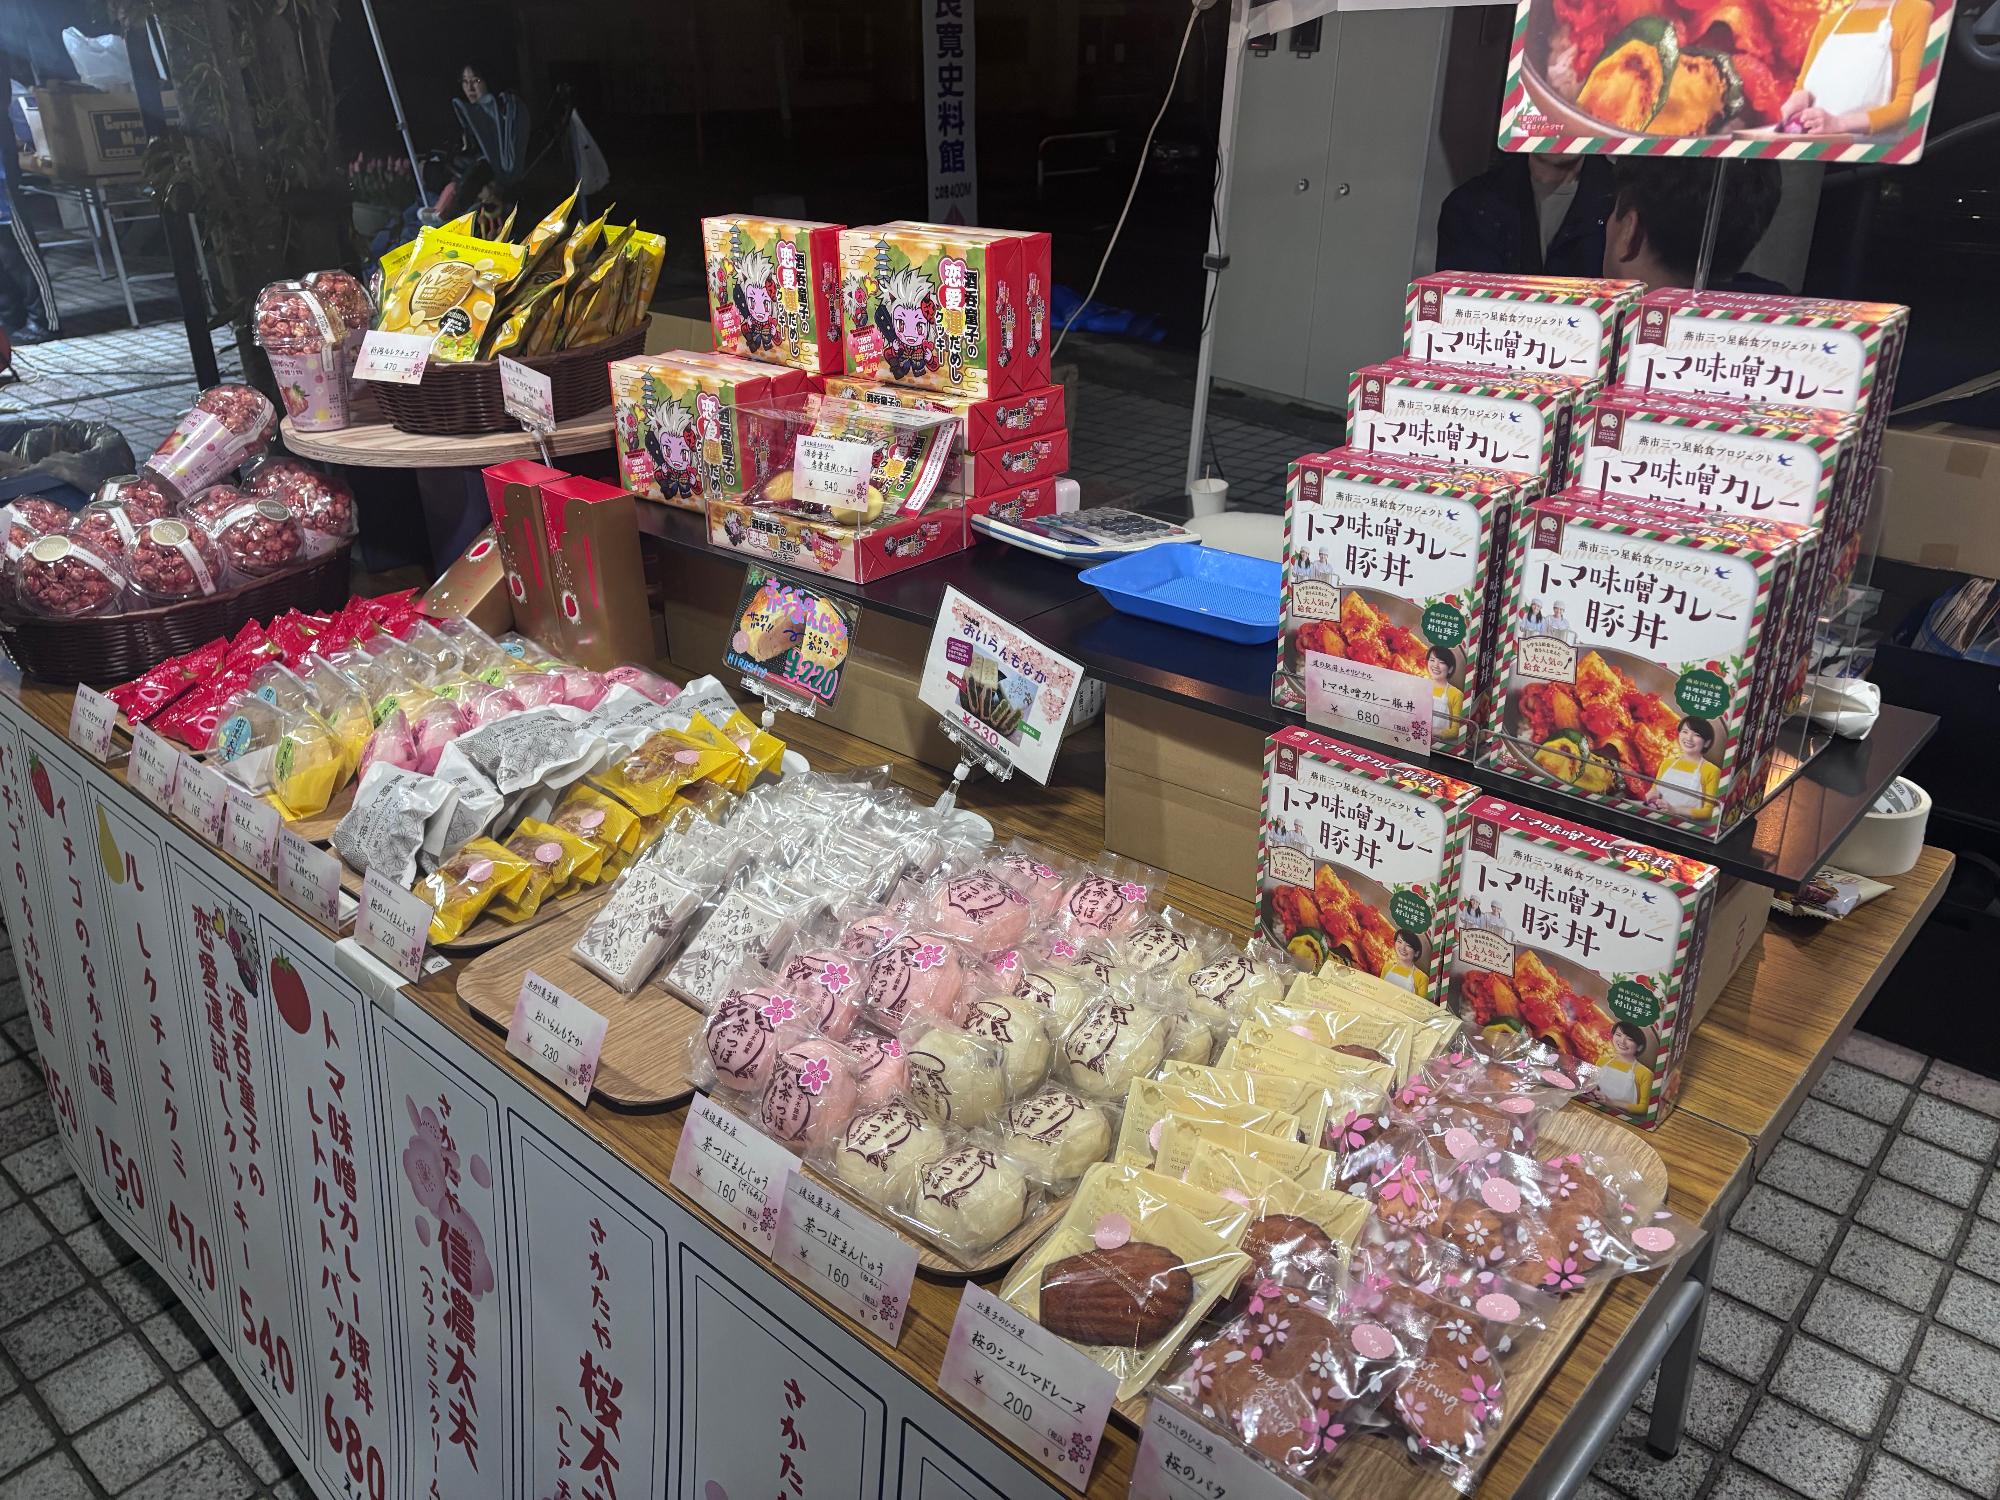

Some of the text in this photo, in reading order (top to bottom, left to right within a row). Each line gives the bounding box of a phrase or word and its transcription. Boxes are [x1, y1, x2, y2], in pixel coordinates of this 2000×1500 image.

[964, 270, 980, 358] 酒呑童子の
[1455, 308, 1563, 327] 燕市三つ星給食プロジェクト
[935, 310, 946, 365] クッキー
[1683, 330, 1817, 352] 燕市三つ星給食プロジェクト
[384, 362, 397, 371] 470
[1397, 399, 1505, 421] 燕市三つ星給食プロジェクト
[804, 448, 830, 460] 酒呑童子
[1638, 435, 1773, 464] 燕市三つ星給食プロジェクト
[824, 480, 839, 492] 540
[1335, 491, 1443, 517] 燕市三つ星給食プロジェクト
[750, 518, 787, 537] 酒呑童子の
[772, 550, 796, 563] クッキー
[1345, 543, 1414, 587] 豚丼
[1577, 539, 1710, 576] 燕市三つ星給食プロジェクト
[1586, 598, 1669, 650] 豚丼
[784, 648, 839, 699] ¥220
[963, 622, 1047, 684] おいらんもなか
[1321, 679, 1416, 712] トマ味噌カレー豚丼
[1357, 709, 1380, 726] 680
[962, 711, 999, 747] ¥230
[1310, 770, 1411, 813] 燕市三つ星給食プロジェクト
[242, 839, 252, 855] 165
[1319, 820, 1384, 869] 豚丼
[301, 885, 314, 901] 220
[1512, 848, 1639, 898] 燕市三つ星給食プロジェクト
[370, 897, 416, 937] 桜のパイまんじゅう
[382, 930, 395, 947] 220
[1521, 903, 1601, 958] 豚丼
[57, 796, 117, 1106] イチゴのながれ星
[535, 1010, 583, 1047] おいらんもなか
[719, 1016, 750, 1065] 茶つぼ
[542, 1043, 559, 1063] 230
[192, 903, 250, 1270] 恋愛運試しクッキー
[227, 982, 265, 1197] 酒呑童子の
[856, 1106, 898, 1147] 茶つぼ
[96, 1125, 145, 1209] 150
[700, 1135, 769, 1191] 茶つぼまんじゅう
[323, 1010, 374, 1416] トマ味噌カレー豚丼
[717, 1179, 736, 1204] 160
[168, 1200, 215, 1292] 470
[308, 1087, 347, 1380] レトルトパック
[803, 1216, 884, 1277] 茶つぼまんじゅう
[589, 1217, 612, 1351] さかたや
[826, 1263, 849, 1289] 160
[239, 1286, 295, 1395] 540
[976, 1301, 1026, 1340] お菓子のひろ里
[437, 1217, 479, 1475] 信濃太夫
[971, 1330, 1087, 1415] 桜のシェルマドレーヌ
[780, 1378, 807, 1500] さかた
[1002, 1391, 1033, 1422] 200
[1046, 1427, 1068, 1448] (税込)
[1157, 1413, 1214, 1458] おかしのひろ里
[324, 1393, 386, 1500] 680
